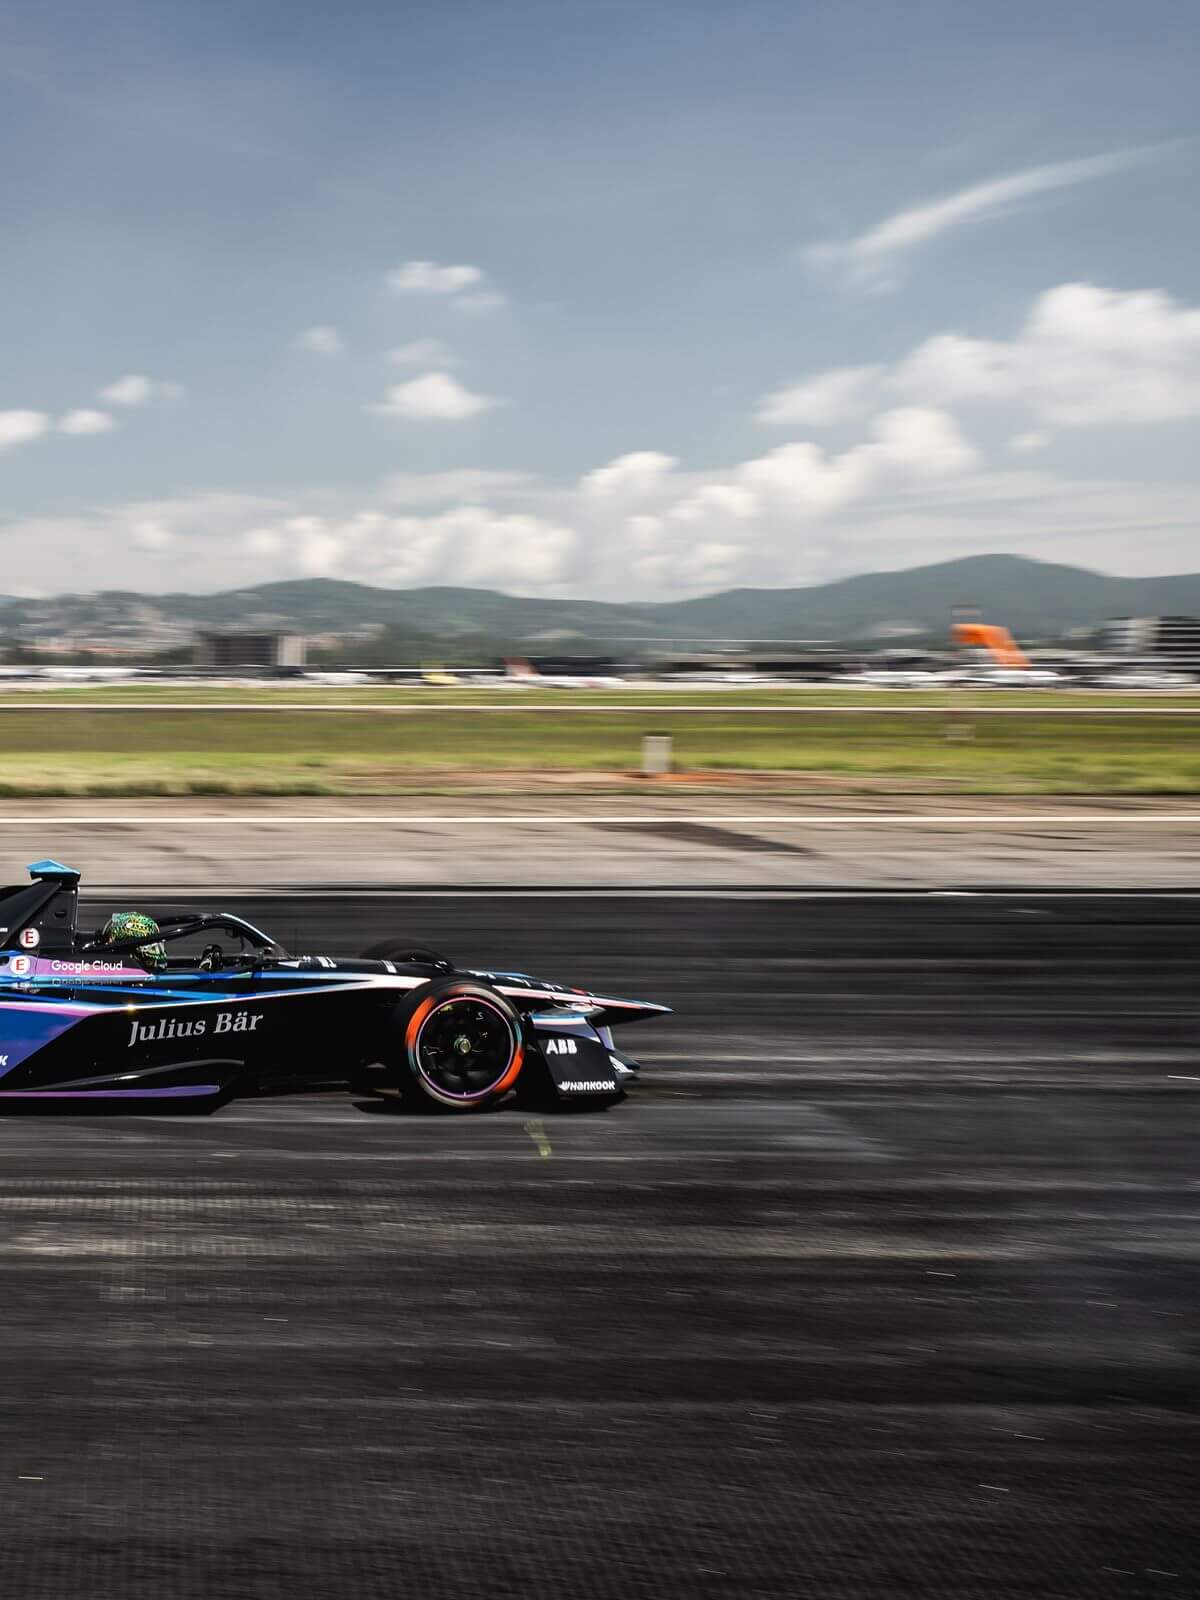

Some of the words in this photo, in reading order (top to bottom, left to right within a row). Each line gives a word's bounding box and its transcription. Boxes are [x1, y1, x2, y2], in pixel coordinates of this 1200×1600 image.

[51, 960, 90, 973] Google
[92, 960, 123, 971] Cloud
[128, 1018, 206, 1047] Julius
[213, 1011, 264, 1034] Bär
[546, 1039, 577, 1054] ABB
